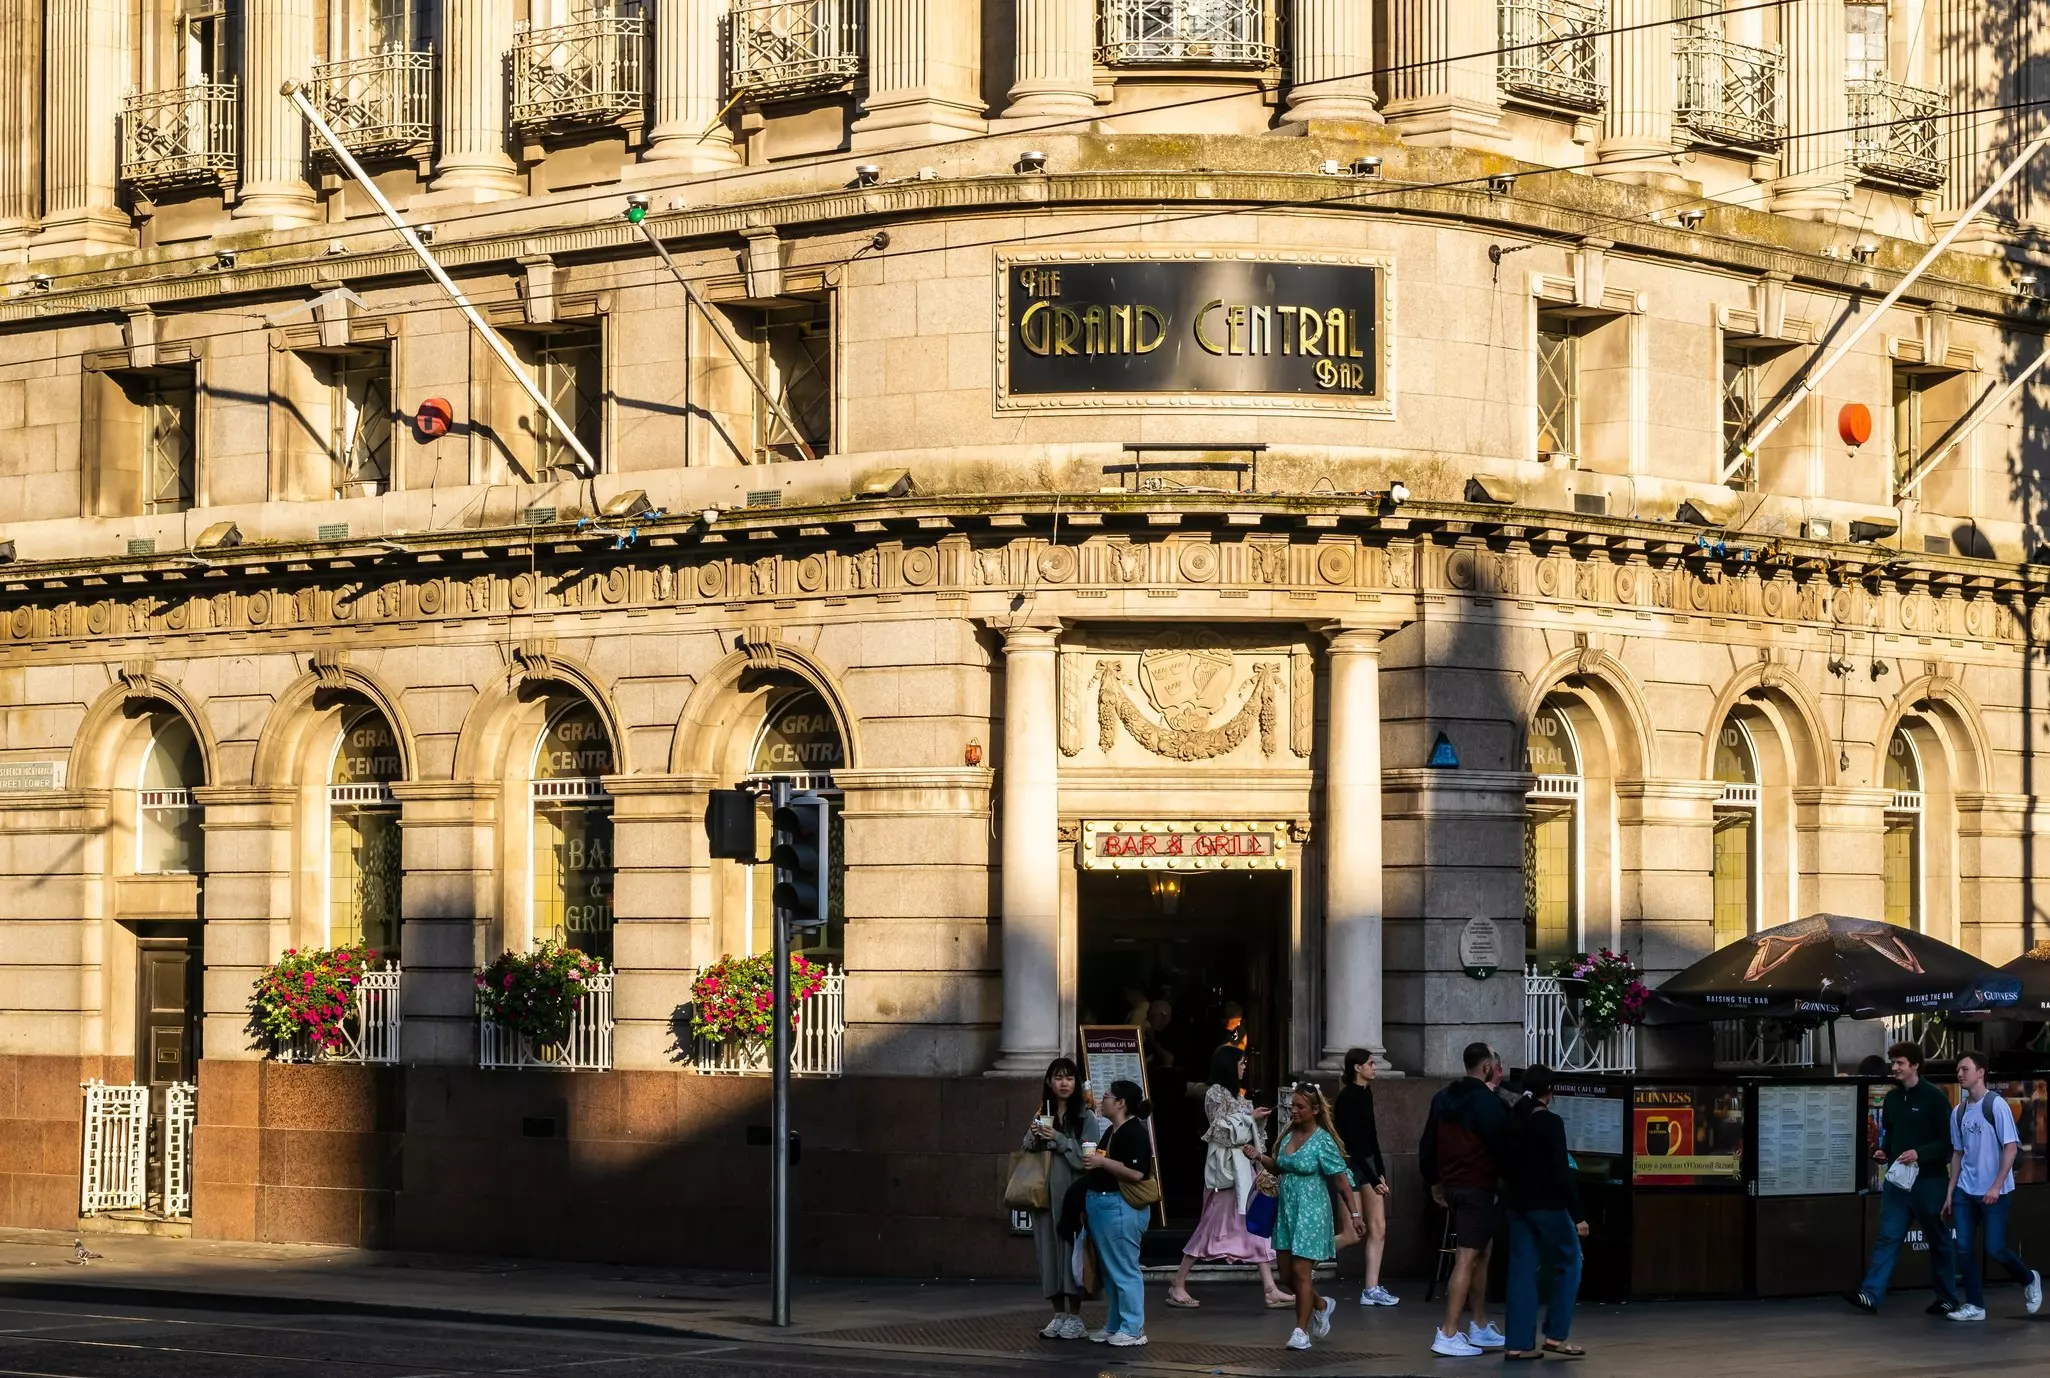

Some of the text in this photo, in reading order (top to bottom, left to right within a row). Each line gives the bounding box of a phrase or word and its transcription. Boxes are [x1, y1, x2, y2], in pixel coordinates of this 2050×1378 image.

[1020, 268, 1060, 297] THE
[1020, 299, 1364, 358] GRAND CENTRAL
[1313, 360, 1363, 390] BAR
[1525, 746, 1566, 766] TRAL
[25, 779, 50, 788] LOWER
[1104, 833, 1266, 857] BAR & GRILL
[590, 876, 602, 898] &
[1706, 995, 1769, 1005] RAISING THE BAR
[1906, 991, 1954, 1003] RAISING THE BAR
[1984, 991, 2018, 1001] GUINNESS
[1801, 1001, 1840, 1013] GUINNESS
[1553, 1084, 1576, 1092] CENTRAL
[1594, 1086, 1606, 1094] BAR
[1634, 1091, 1692, 1103] GUINNESS
